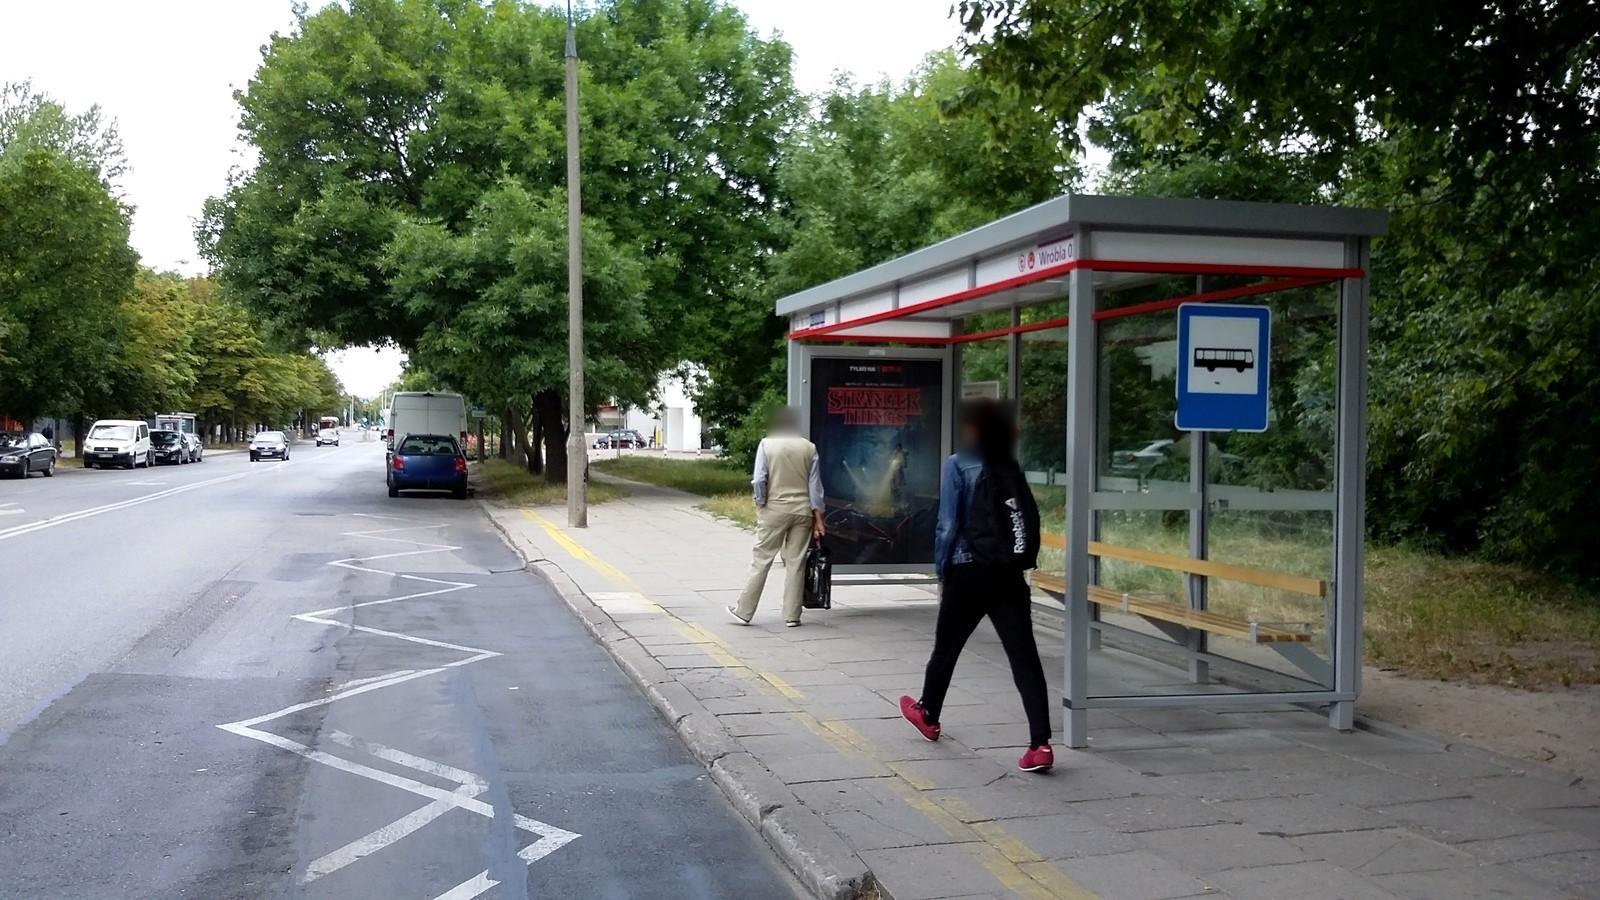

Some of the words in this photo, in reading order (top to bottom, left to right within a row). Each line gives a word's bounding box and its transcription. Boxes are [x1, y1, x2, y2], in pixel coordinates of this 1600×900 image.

[827, 388, 921, 415] STRANGER
[843, 409, 907, 425] THINGS
[1010, 511, 1025, 553] Reebok
